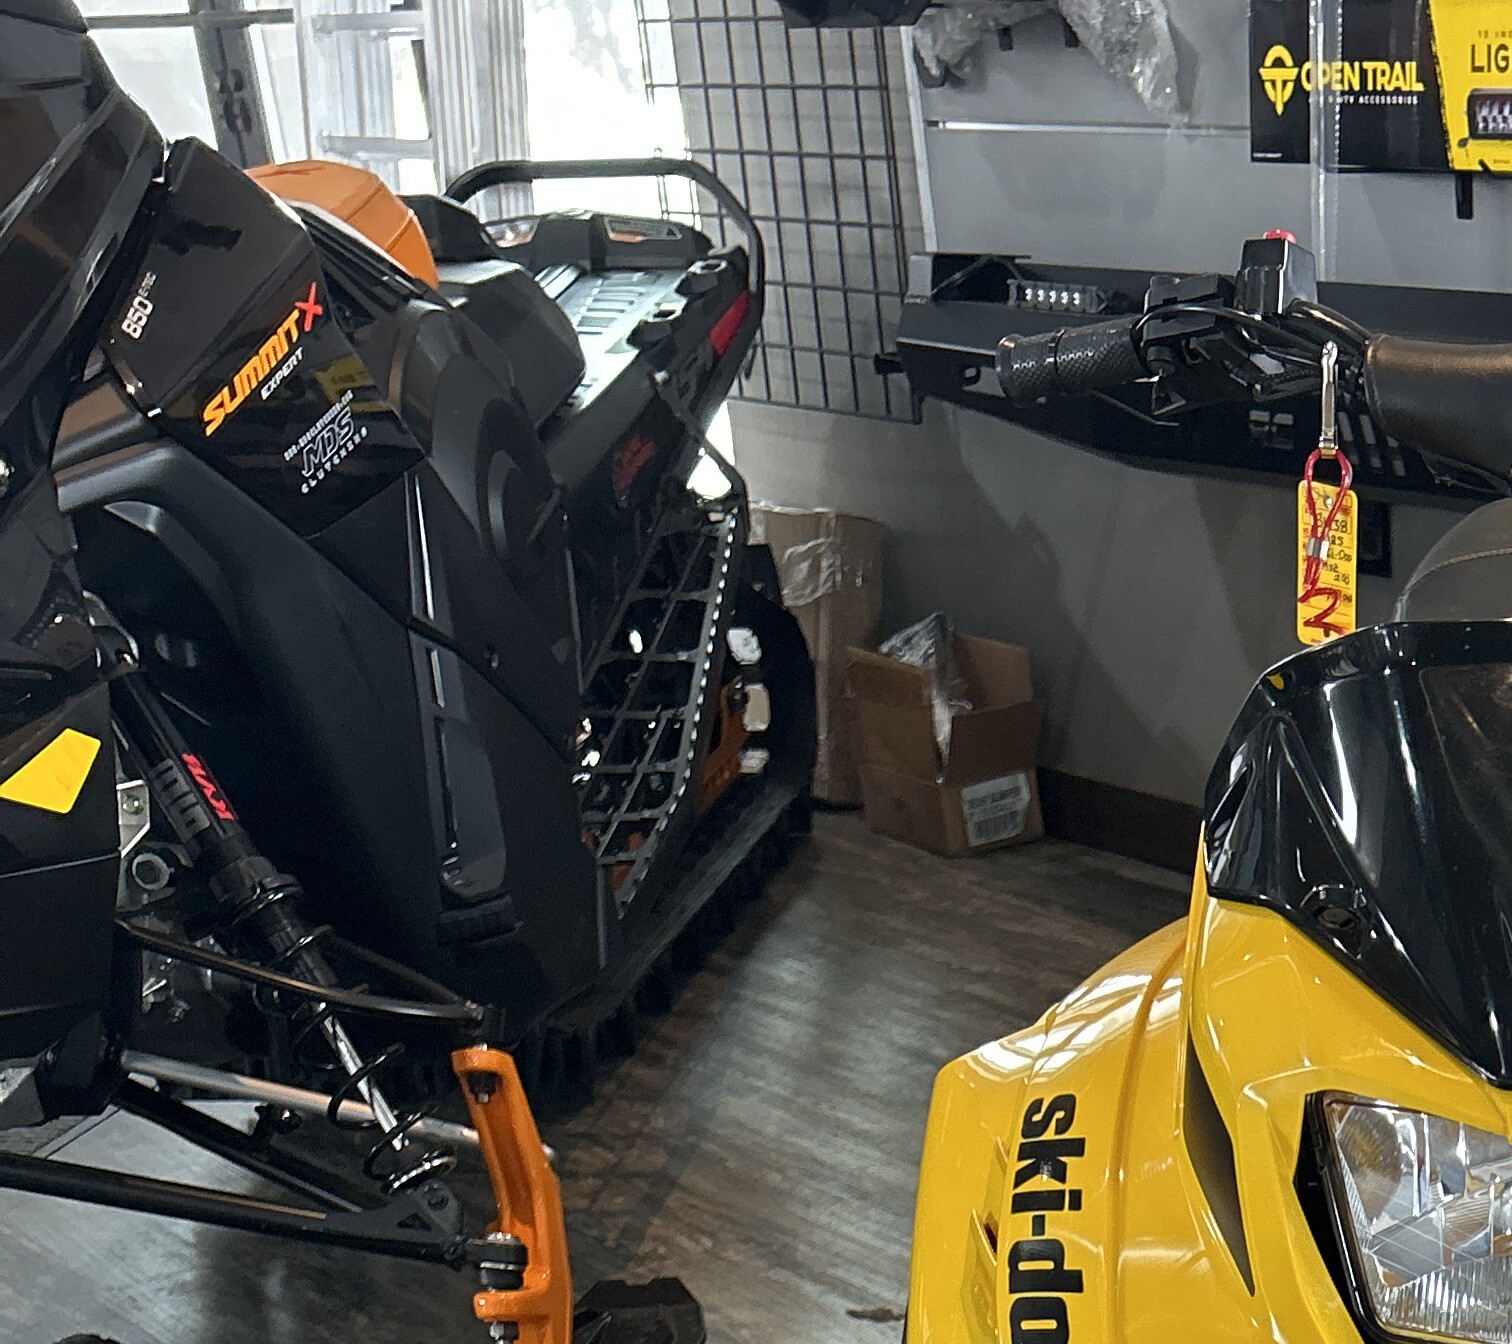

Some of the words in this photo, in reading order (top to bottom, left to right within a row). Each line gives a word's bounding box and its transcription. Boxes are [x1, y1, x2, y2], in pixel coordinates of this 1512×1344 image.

[1301, 61, 1361, 92] OPEN
[1362, 61, 1425, 92] TRAIL
[121, 295, 154, 340] 850
[203, 308, 300, 438] SUMMIT
[294, 281, 323, 333] X
[260, 347, 304, 400] EXPERT
[301, 405, 355, 478] MDS
